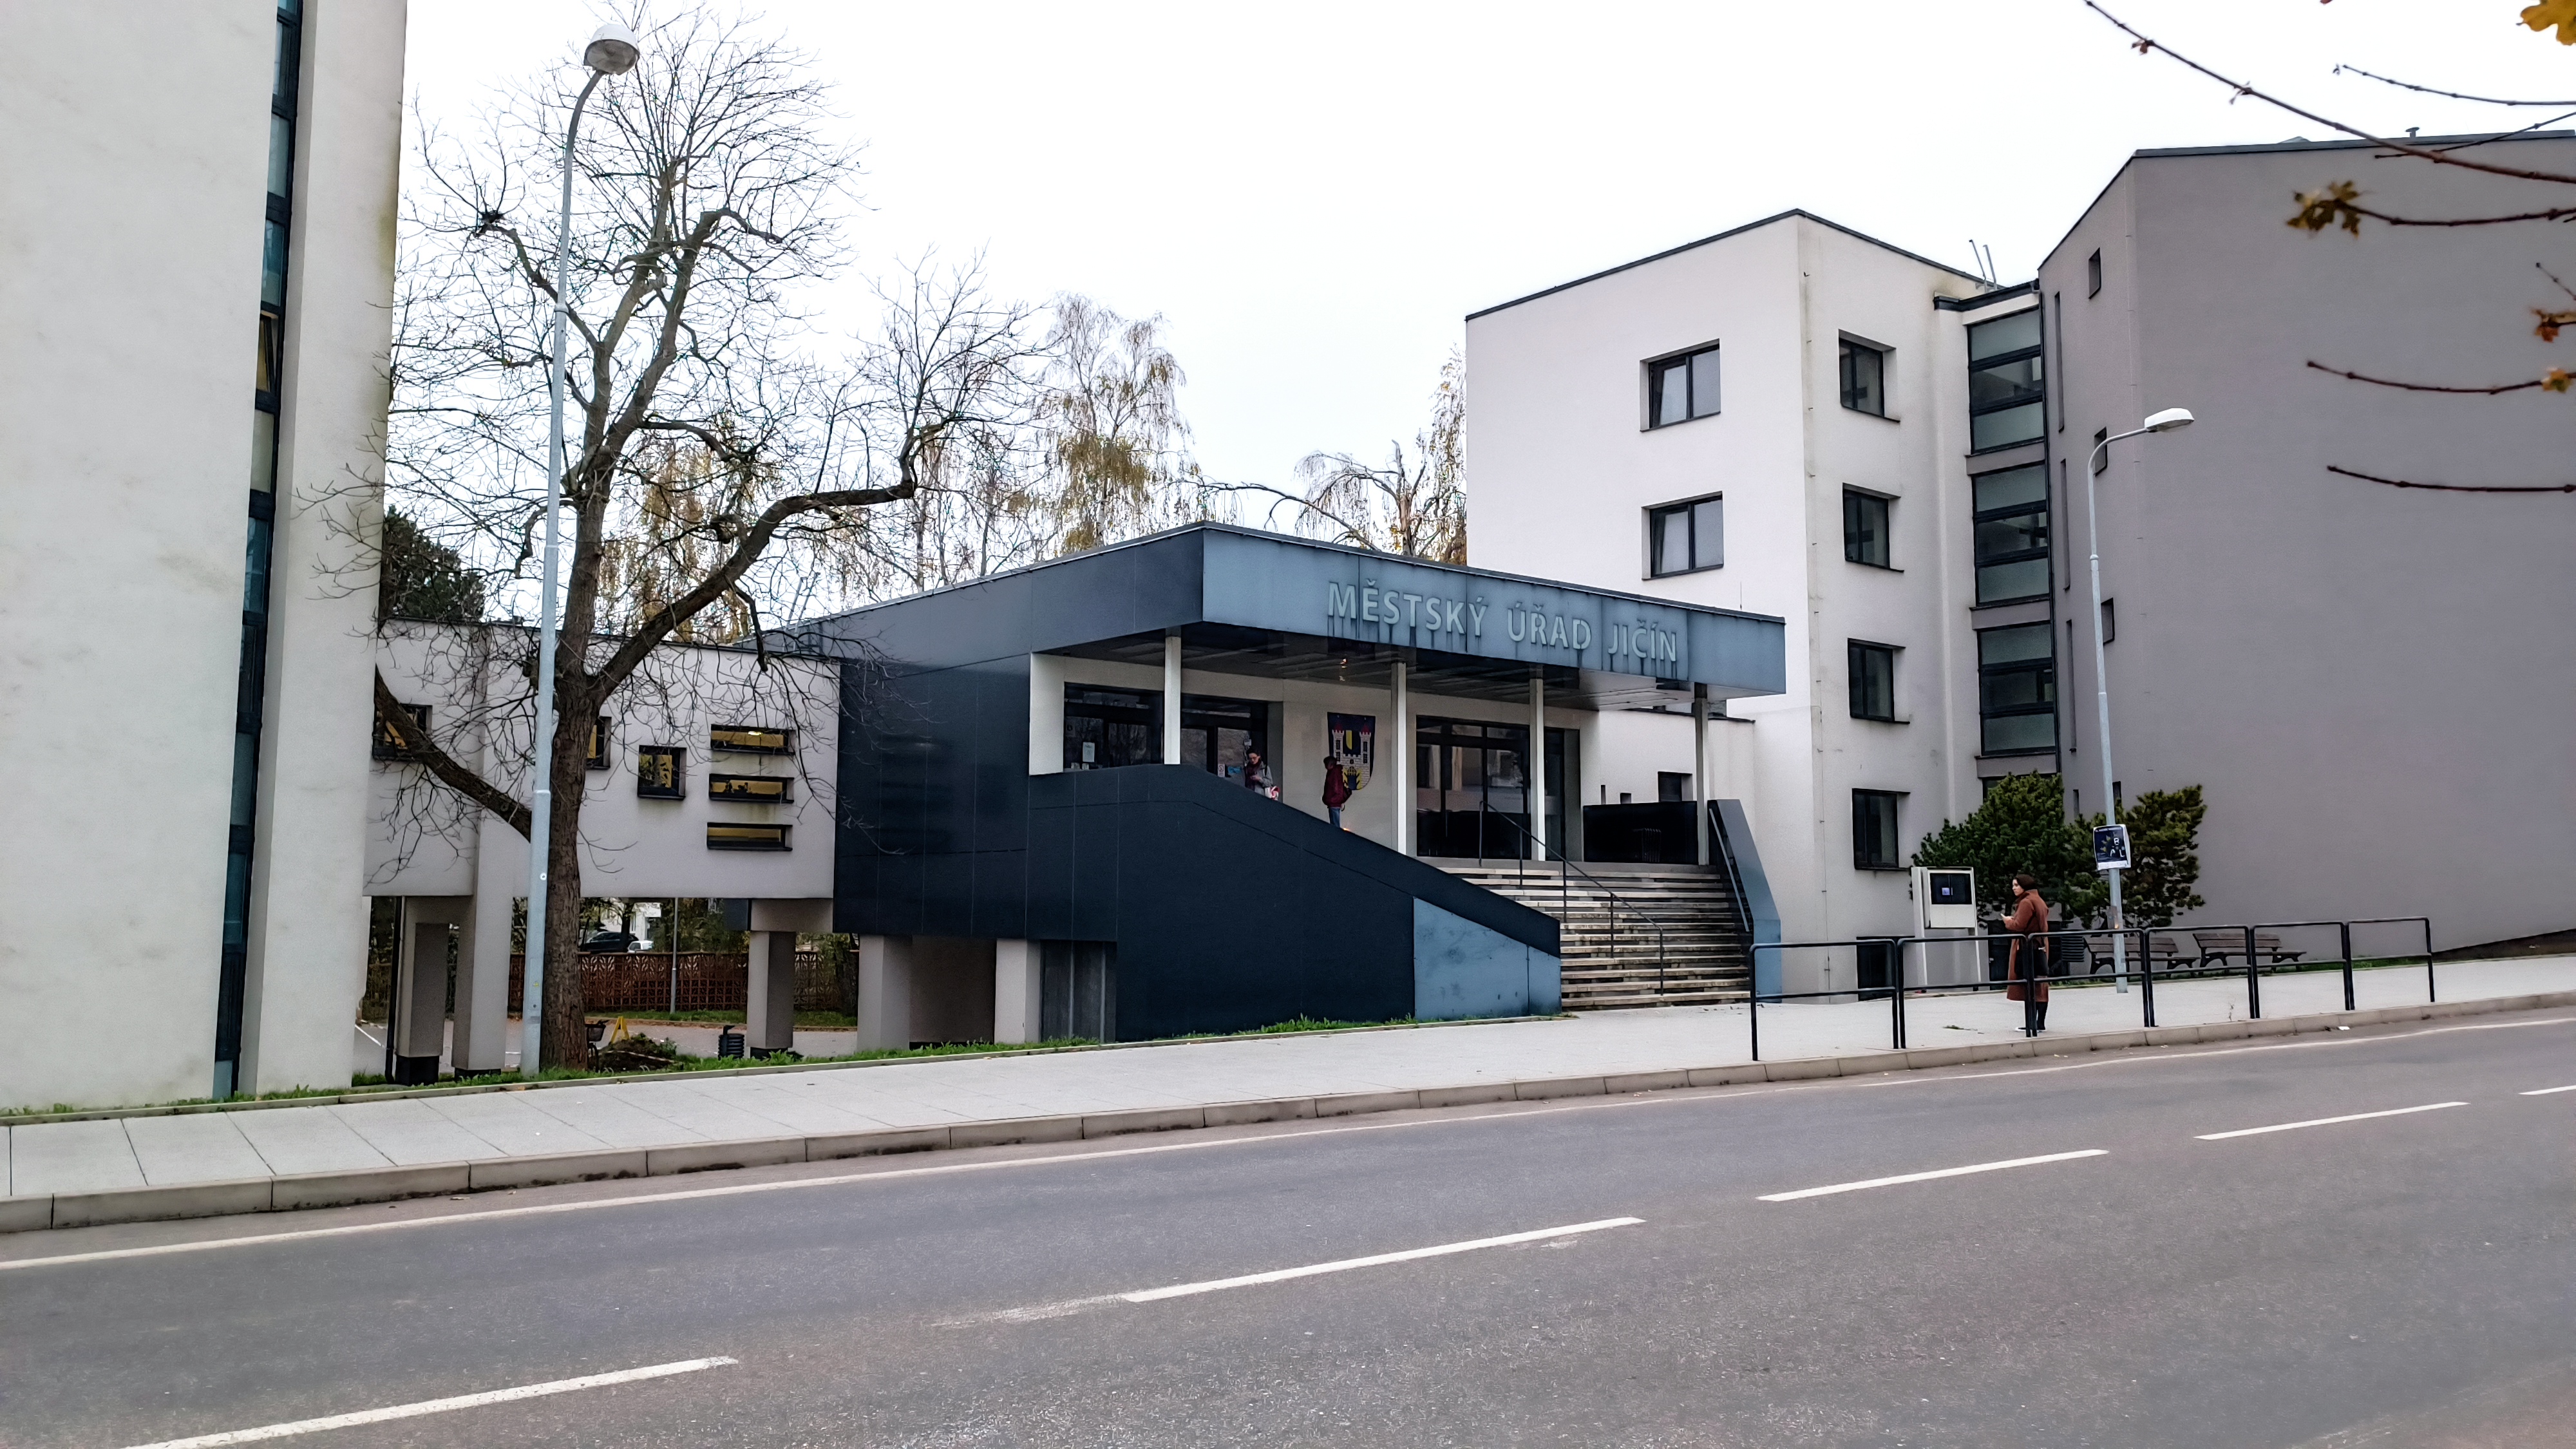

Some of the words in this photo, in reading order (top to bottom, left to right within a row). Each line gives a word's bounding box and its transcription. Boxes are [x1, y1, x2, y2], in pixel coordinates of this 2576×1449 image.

[1328, 579, 1488, 637] MĚSTSKÝ
[1508, 601, 1591, 650] ÚŘAD
[1608, 620, 1676, 662] JIČÍN
